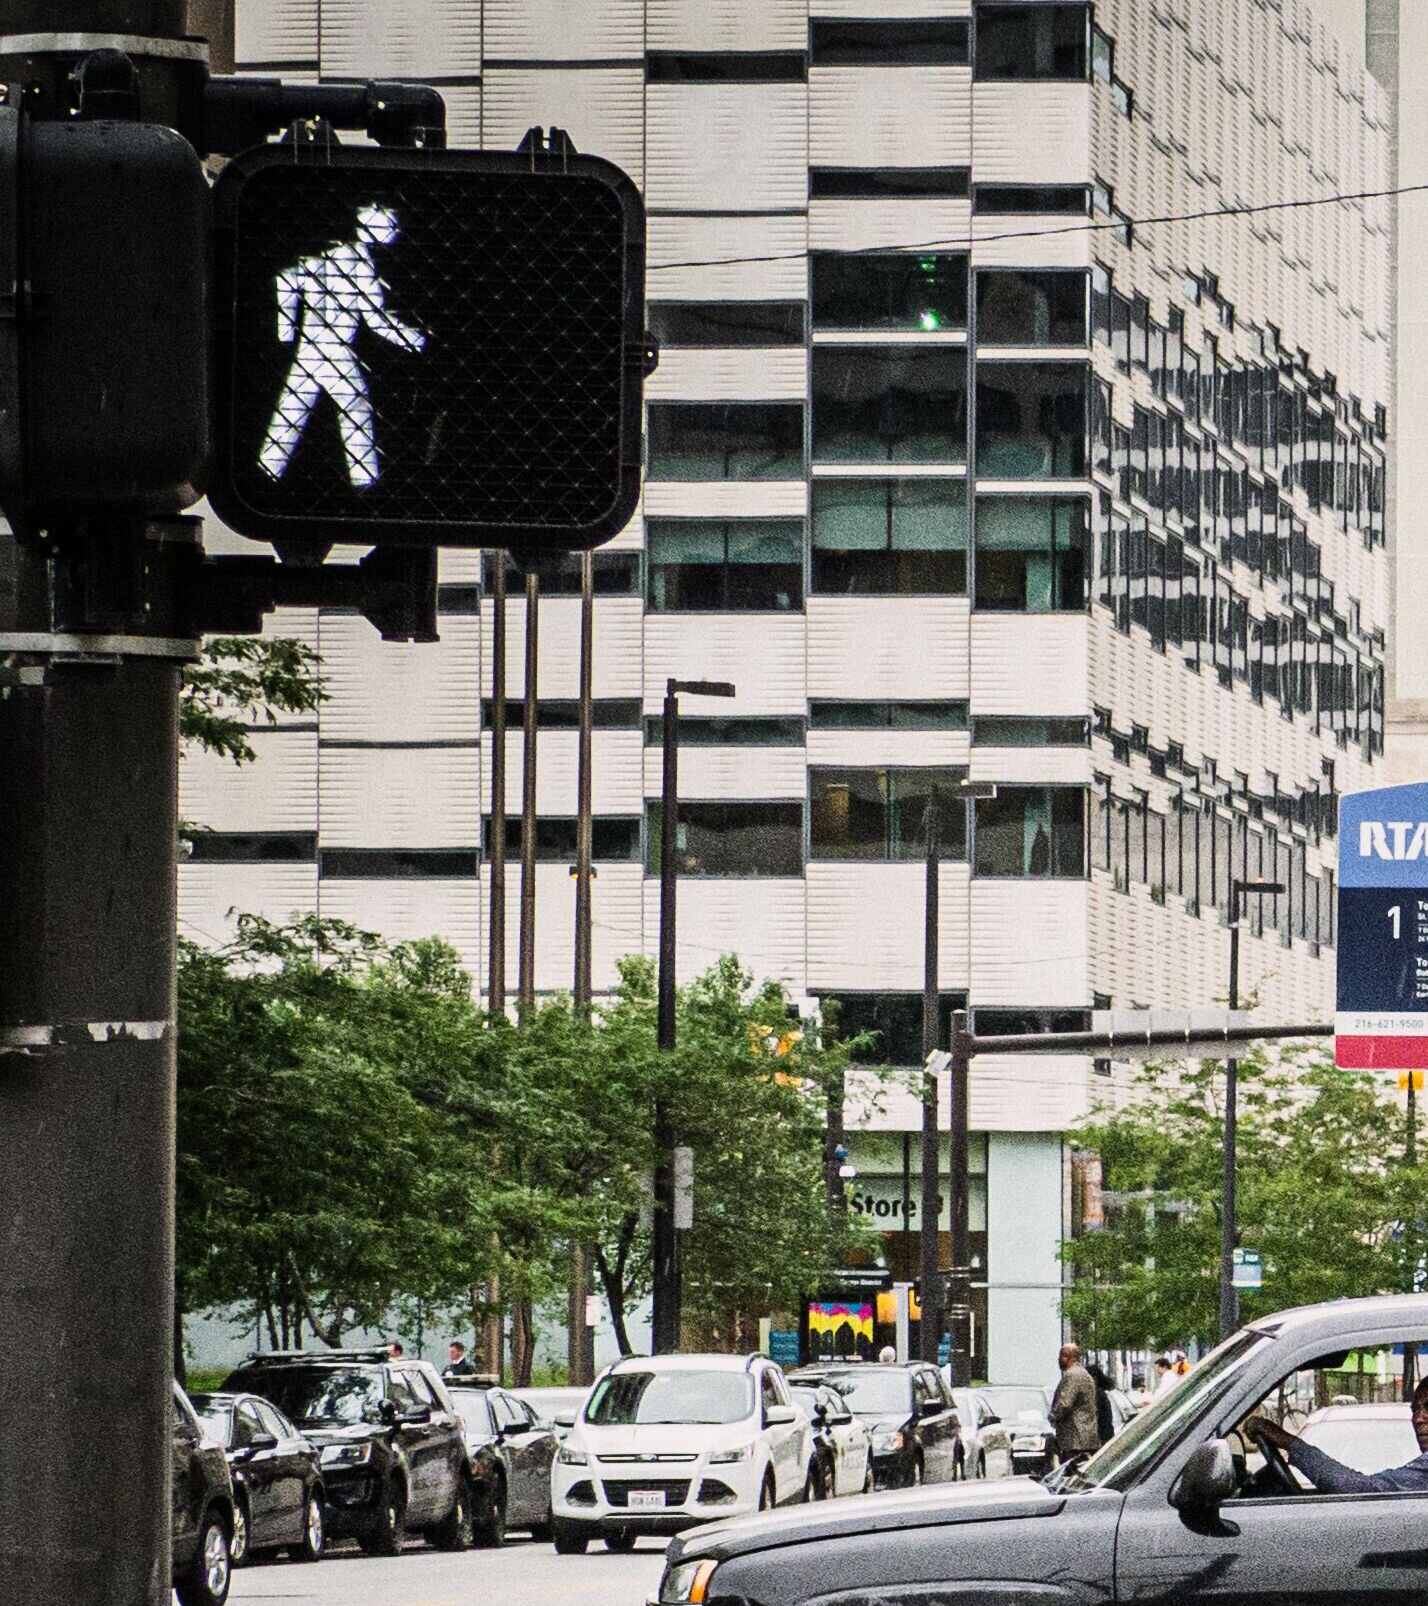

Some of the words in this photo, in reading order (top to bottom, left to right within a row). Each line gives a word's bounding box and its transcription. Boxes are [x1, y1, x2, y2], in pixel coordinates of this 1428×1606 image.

[1387, 905, 1401, 940] 1
[1416, 957, 1428, 967] To
[850, 1192, 918, 1218] Store
